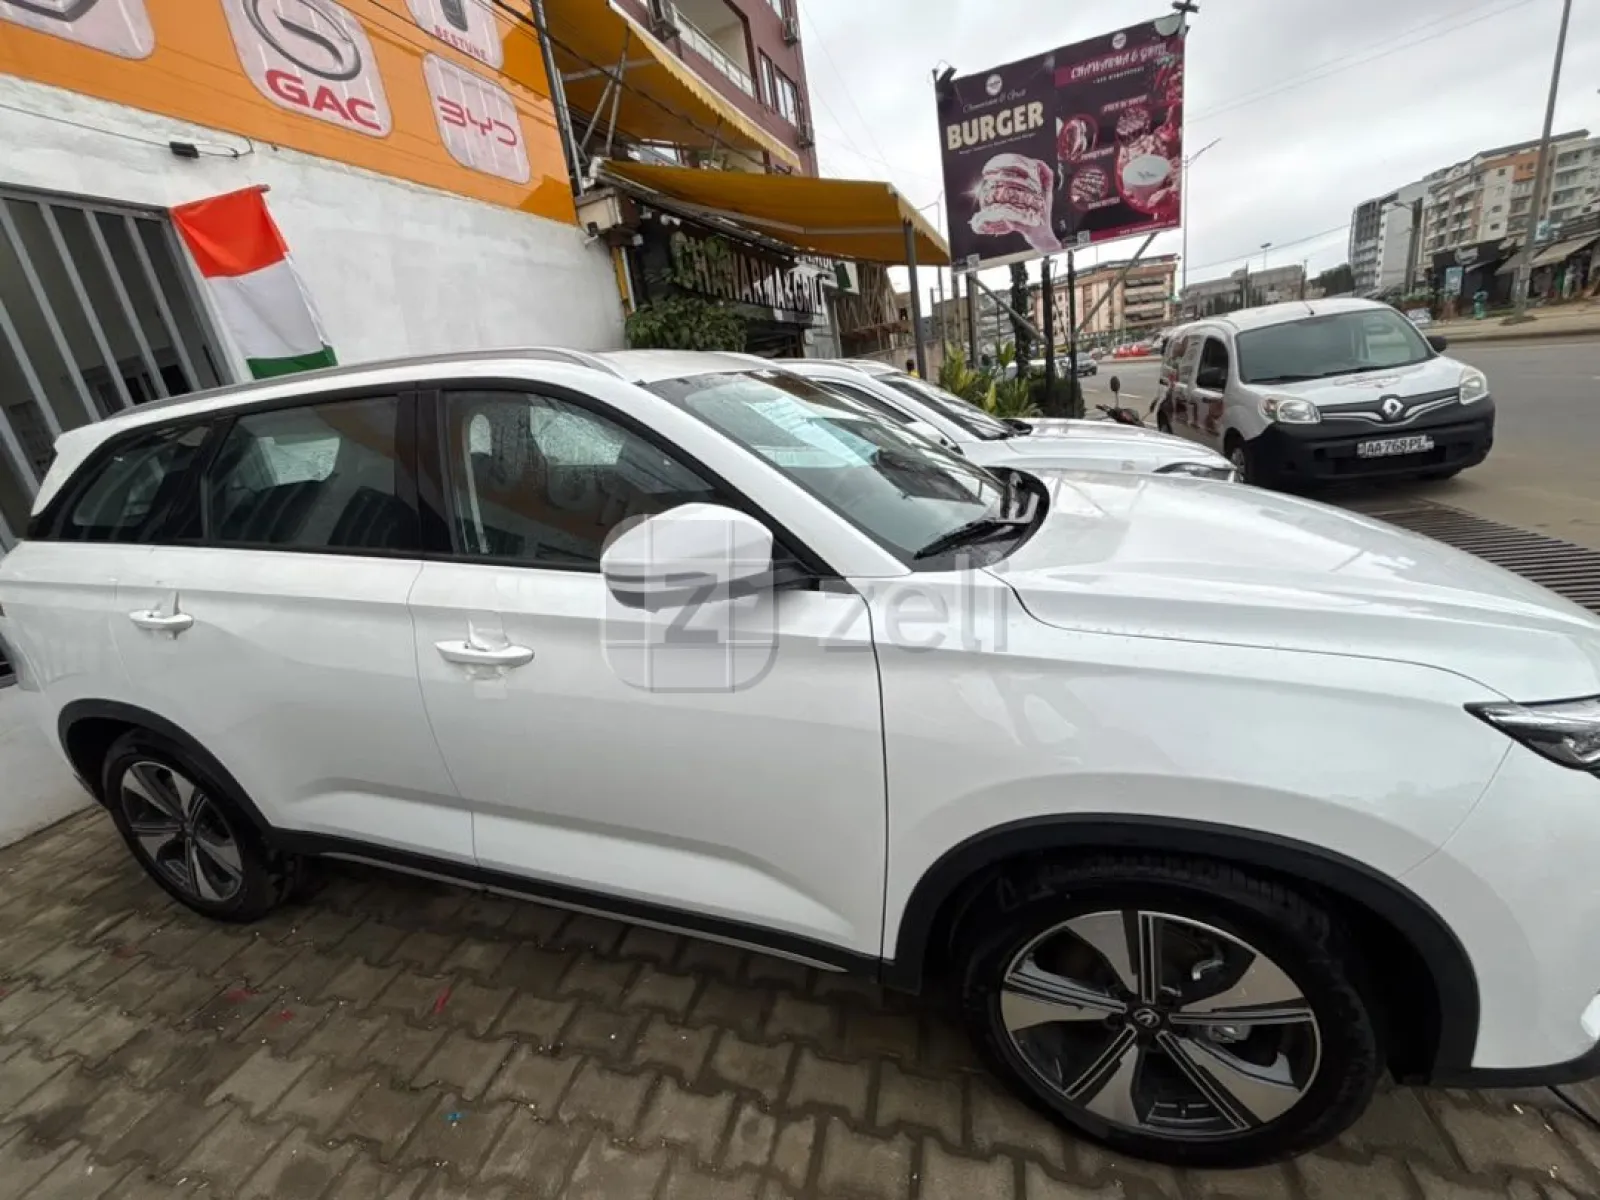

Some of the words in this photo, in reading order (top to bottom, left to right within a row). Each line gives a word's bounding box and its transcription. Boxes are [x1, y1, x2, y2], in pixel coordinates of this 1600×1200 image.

[434, 25, 488, 61] BESTUNE
[265, 69, 382, 131] GAC
[436, 96, 517, 146] BYD
[947, 101, 1044, 150] BURGER
